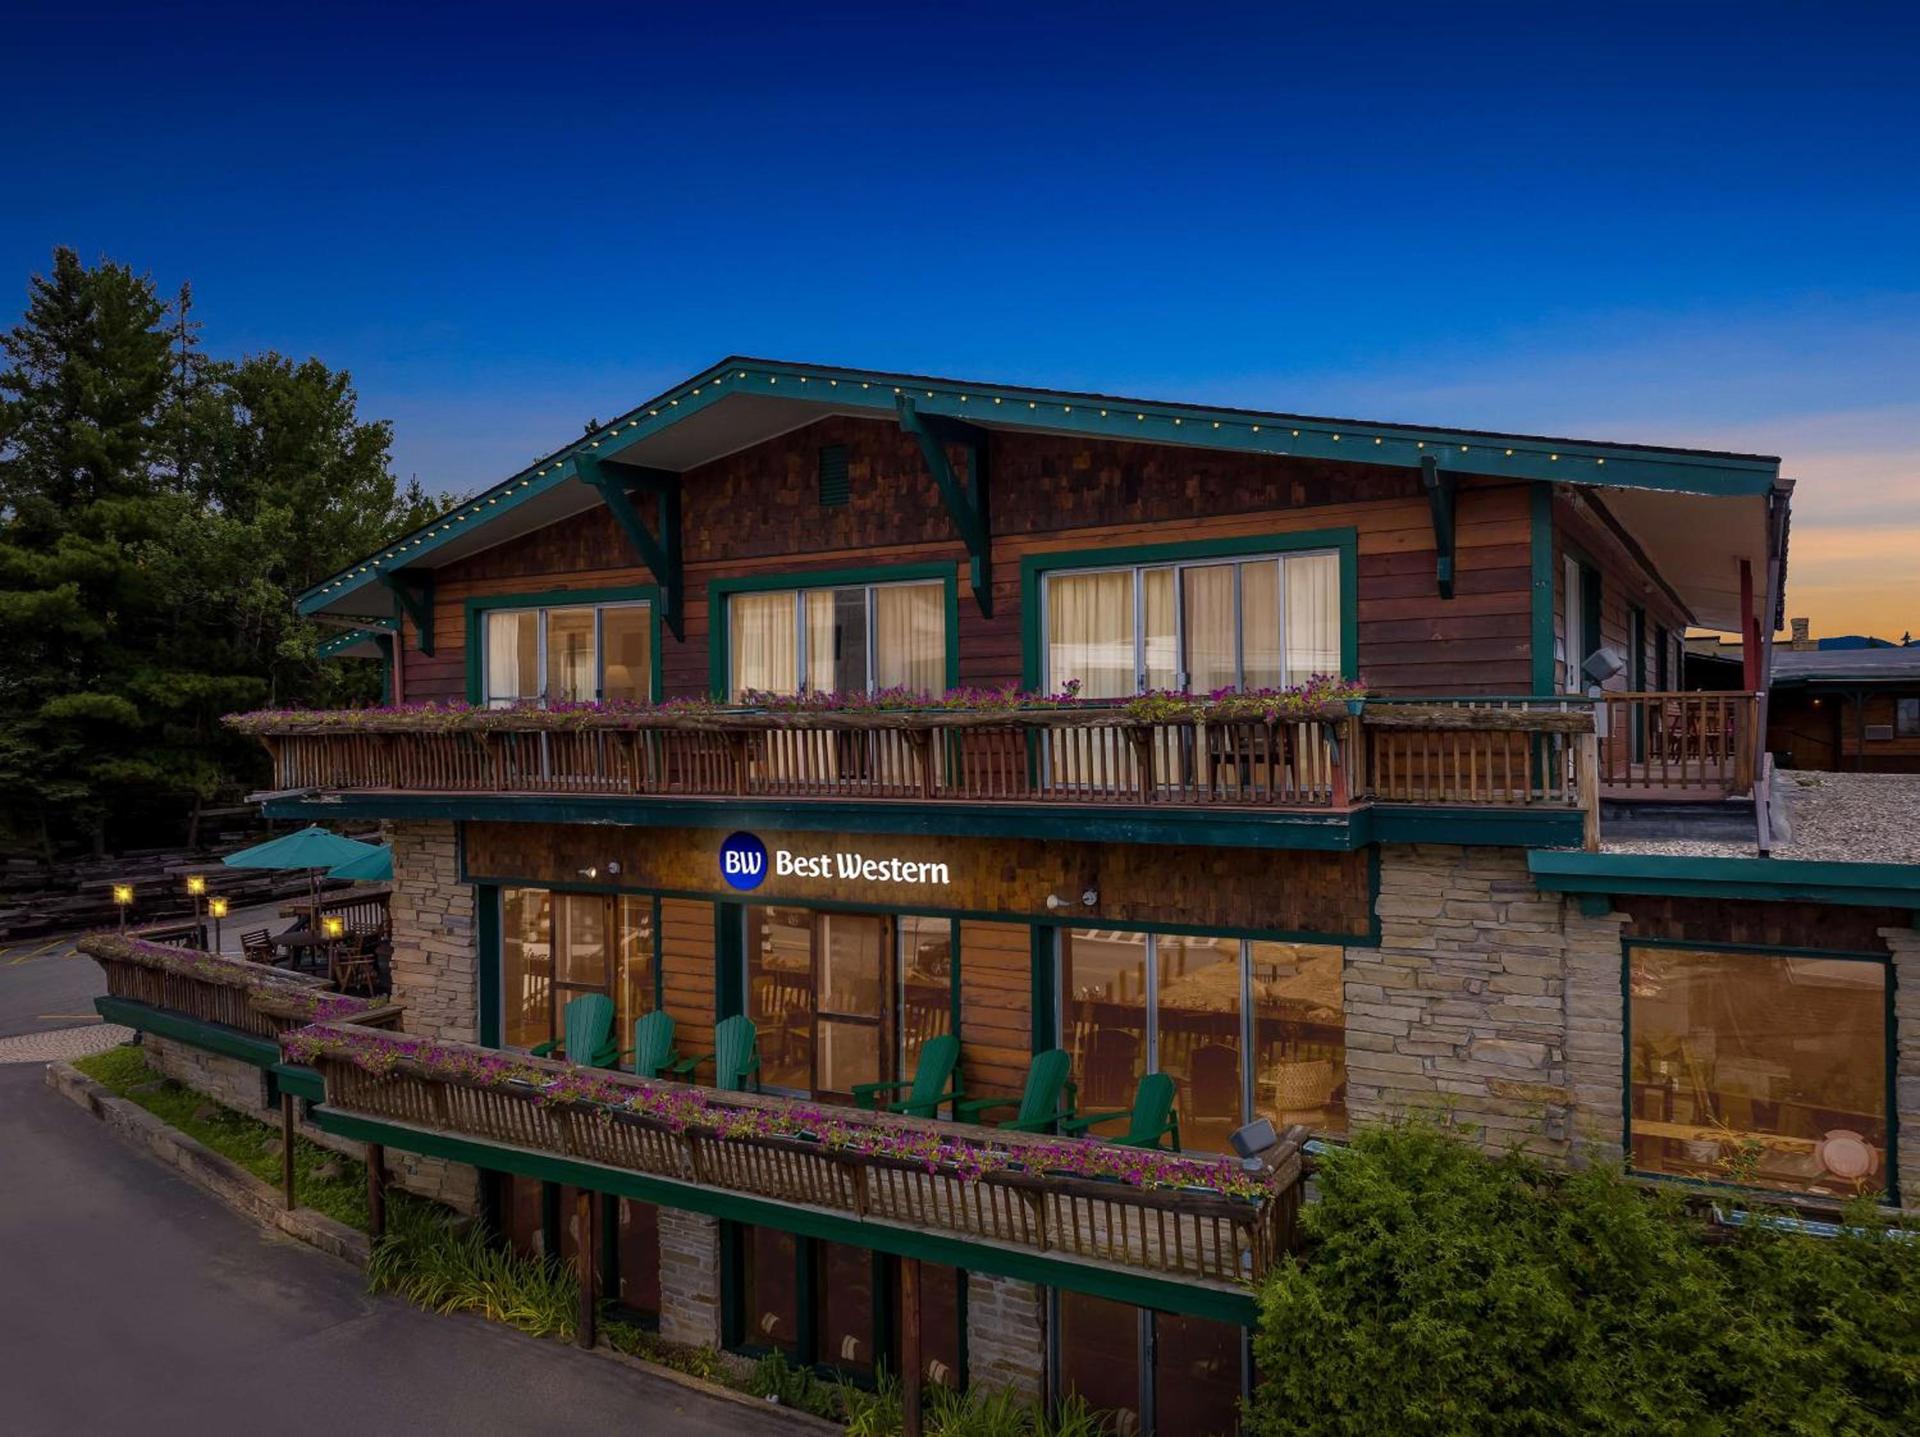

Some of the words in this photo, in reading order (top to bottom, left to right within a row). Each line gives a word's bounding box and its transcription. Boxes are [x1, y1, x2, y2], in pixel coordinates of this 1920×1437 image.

[725, 851, 761, 874] BW
[776, 850, 832, 878] Best
[836, 853, 950, 884] Western
